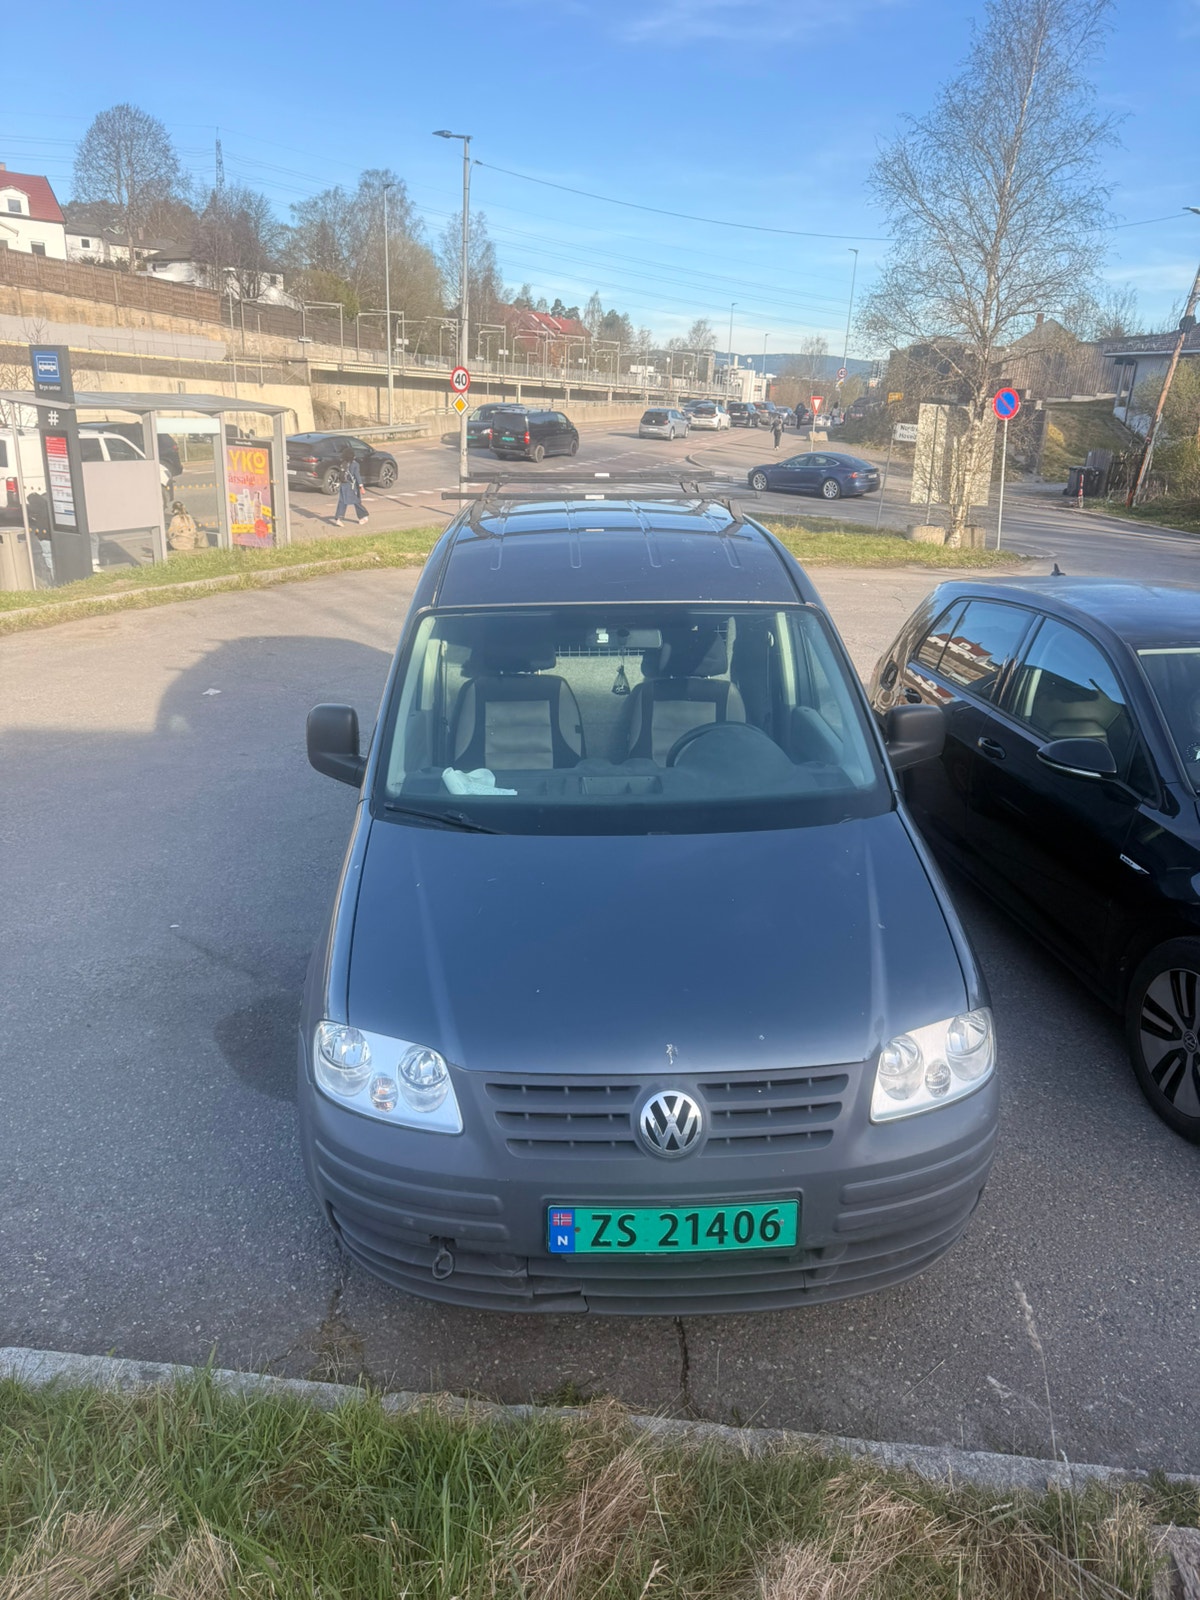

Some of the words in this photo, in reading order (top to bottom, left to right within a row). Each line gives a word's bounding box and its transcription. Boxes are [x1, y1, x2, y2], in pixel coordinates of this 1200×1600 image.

[455, 373, 467, 387] 40
[227, 449, 266, 475] YKO
[590, 1213, 637, 1247] ZS
[658, 1208, 781, 1247] 21406
[557, 1235, 568, 1246] N
